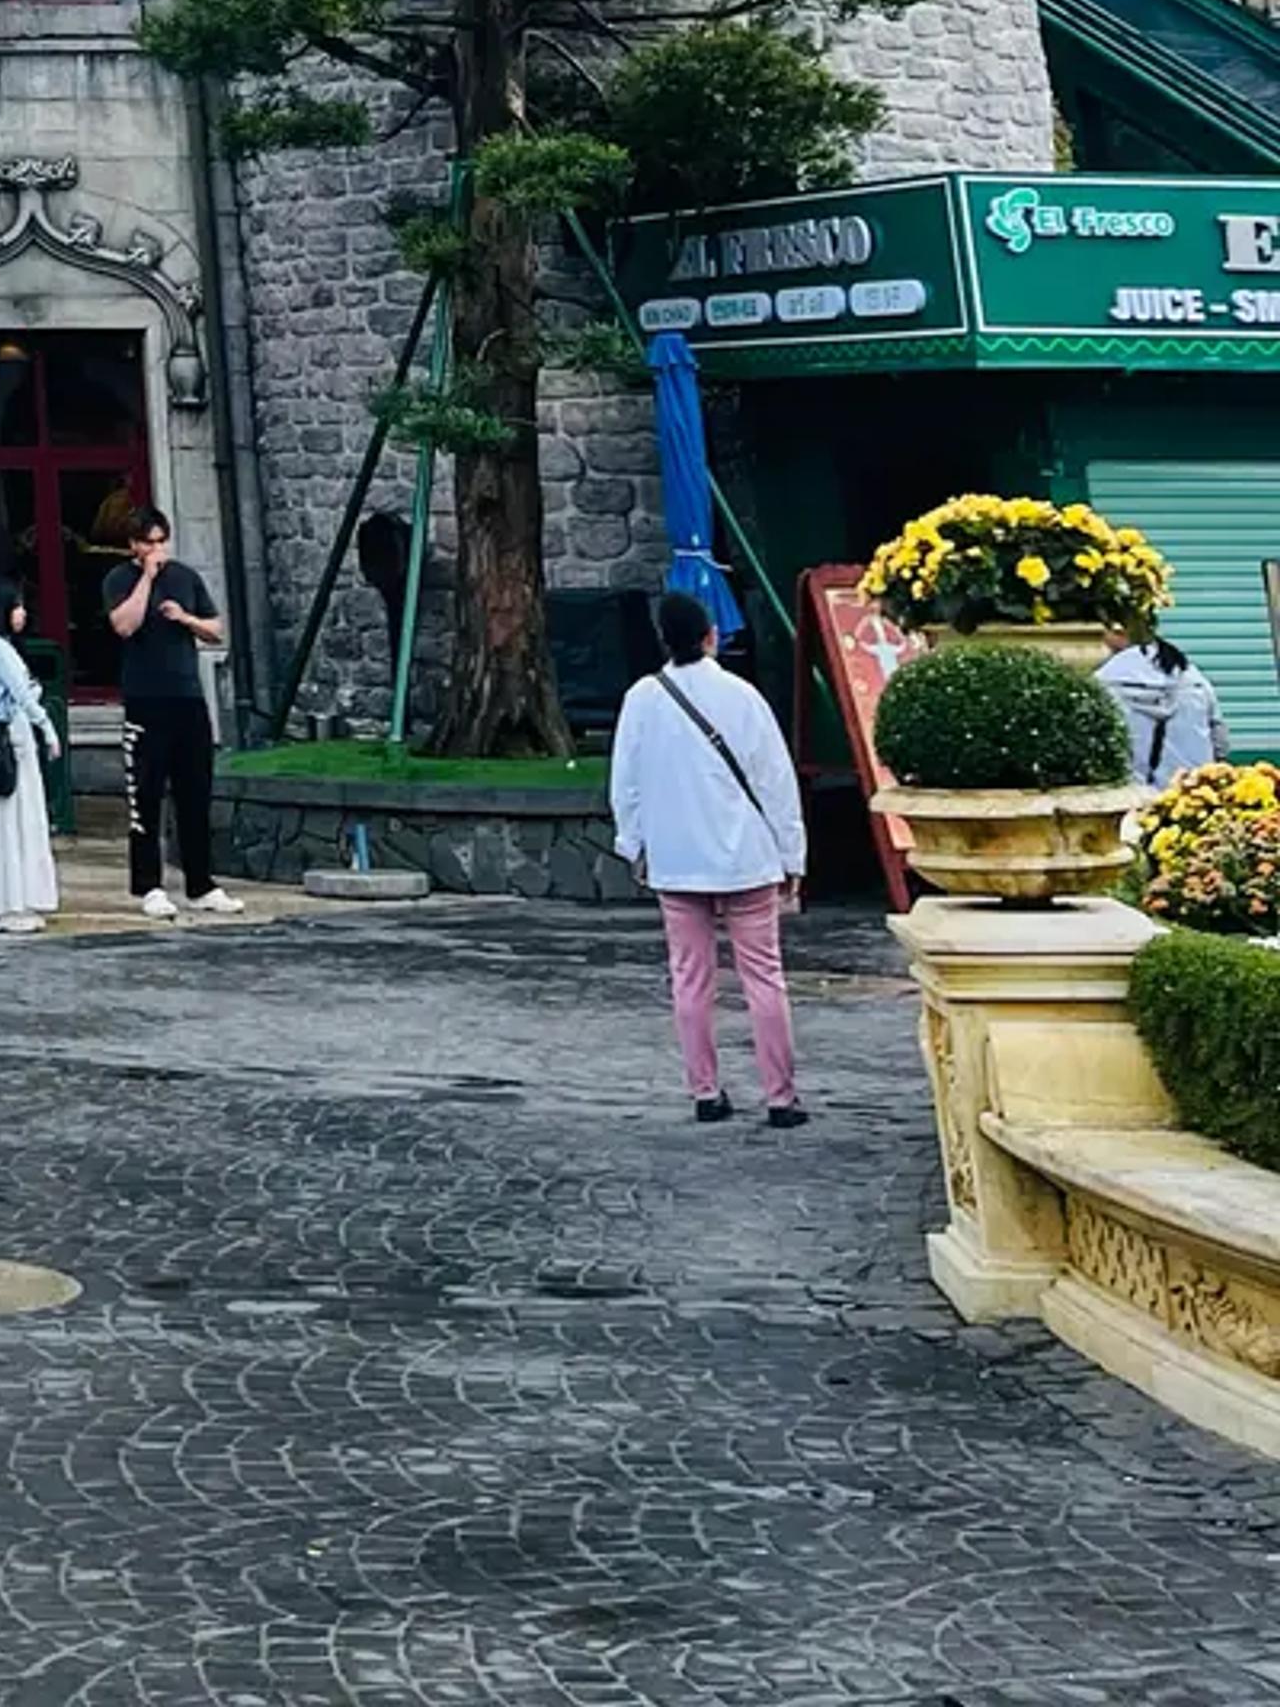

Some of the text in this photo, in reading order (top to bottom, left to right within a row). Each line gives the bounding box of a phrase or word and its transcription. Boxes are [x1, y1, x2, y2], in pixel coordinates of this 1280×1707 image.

[1071, 206, 1174, 236] Fresco
[1217, 214, 1280, 272] E
[719, 215, 872, 277] FRESCO
[1110, 287, 1205, 320] JUICE
